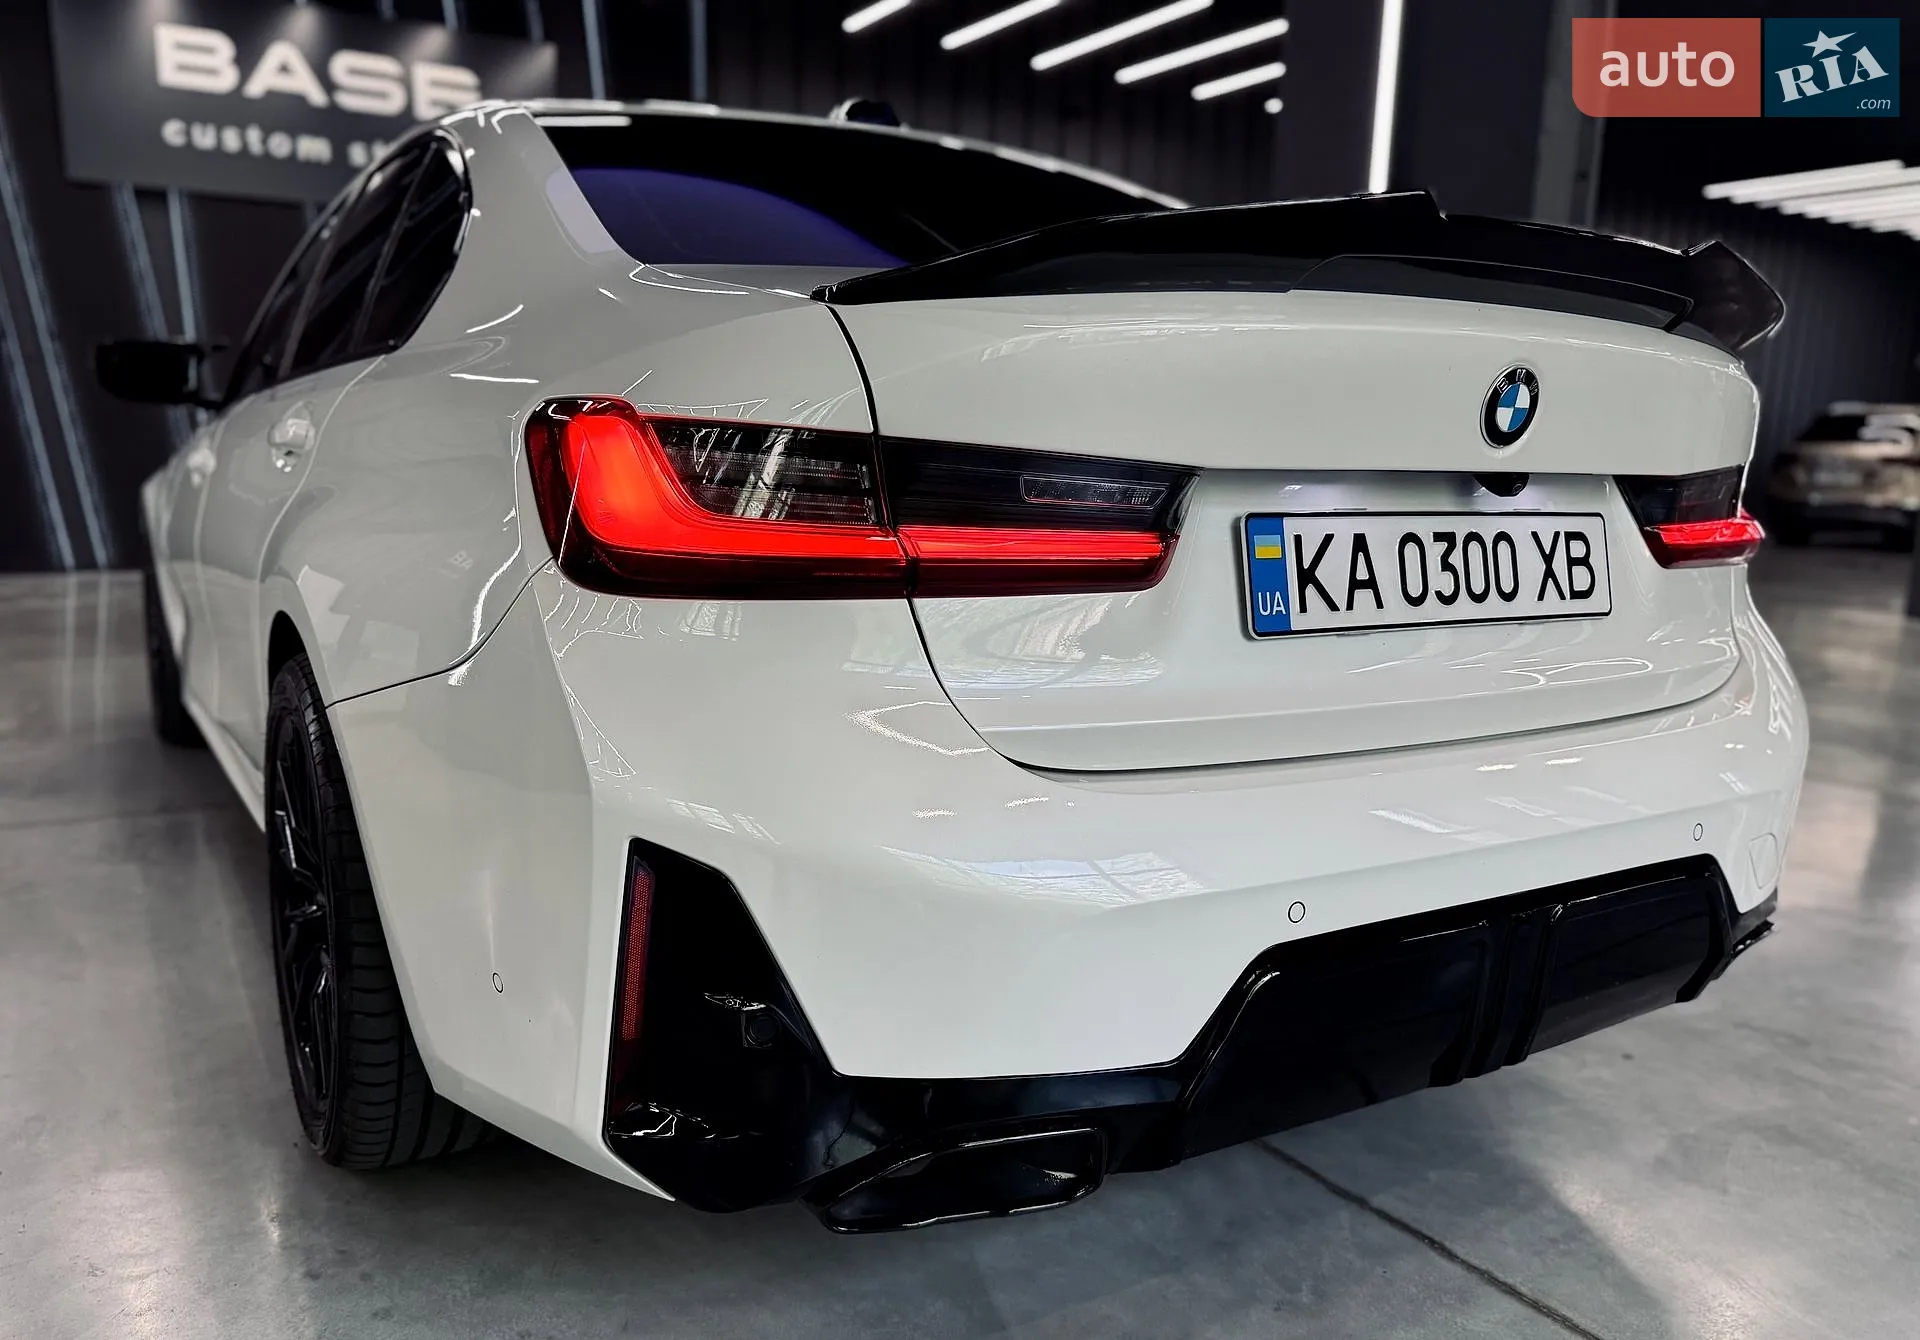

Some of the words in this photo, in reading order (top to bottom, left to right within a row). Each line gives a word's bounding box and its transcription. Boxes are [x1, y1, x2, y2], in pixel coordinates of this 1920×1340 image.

[153, 22, 482, 121] BASE
[161, 117, 332, 165] custom
[1258, 591, 1286, 616] UA
[1293, 532, 1384, 614] KA
[1398, 531, 1519, 608] 0300
[1531, 530, 1596, 602] XB
